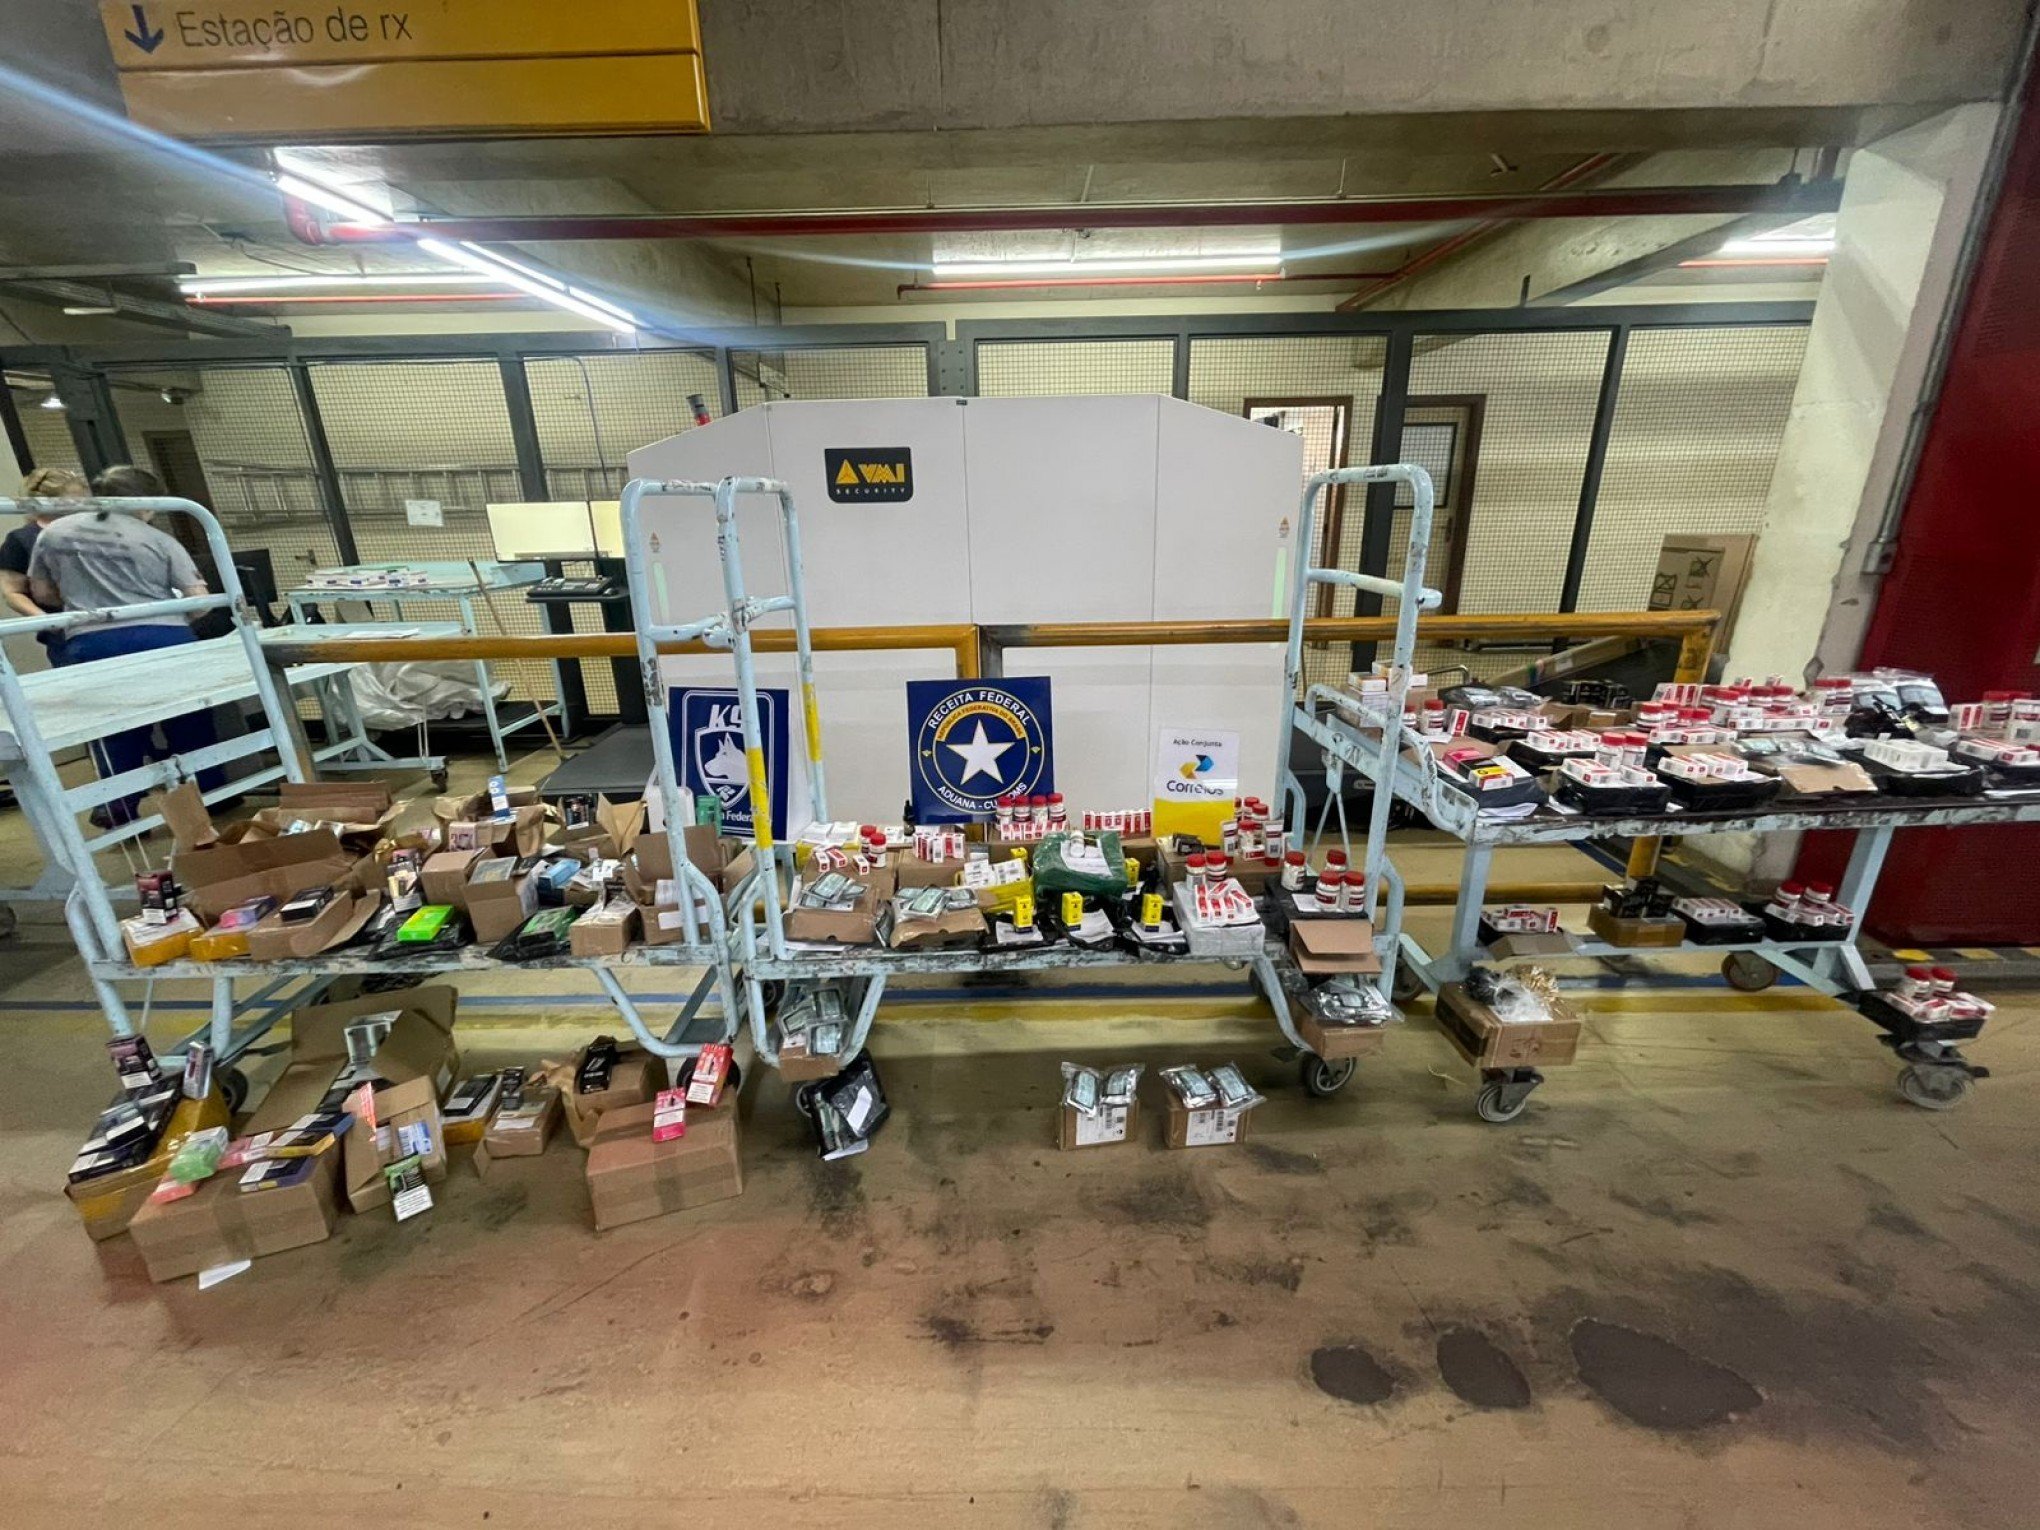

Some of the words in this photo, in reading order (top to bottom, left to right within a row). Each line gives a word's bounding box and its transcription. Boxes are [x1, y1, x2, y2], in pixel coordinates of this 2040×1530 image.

[176, 10, 314, 52] Estação
[325, 6, 368, 42] de
[380, 13, 412, 40] rx
[928, 692, 974, 729] RECEITA
[979, 691, 1031, 726] FEDERAL
[1190, 739, 1222, 748] Conjunta
[937, 785, 976, 810] ADUANA
[726, 810, 752, 822] Feder
